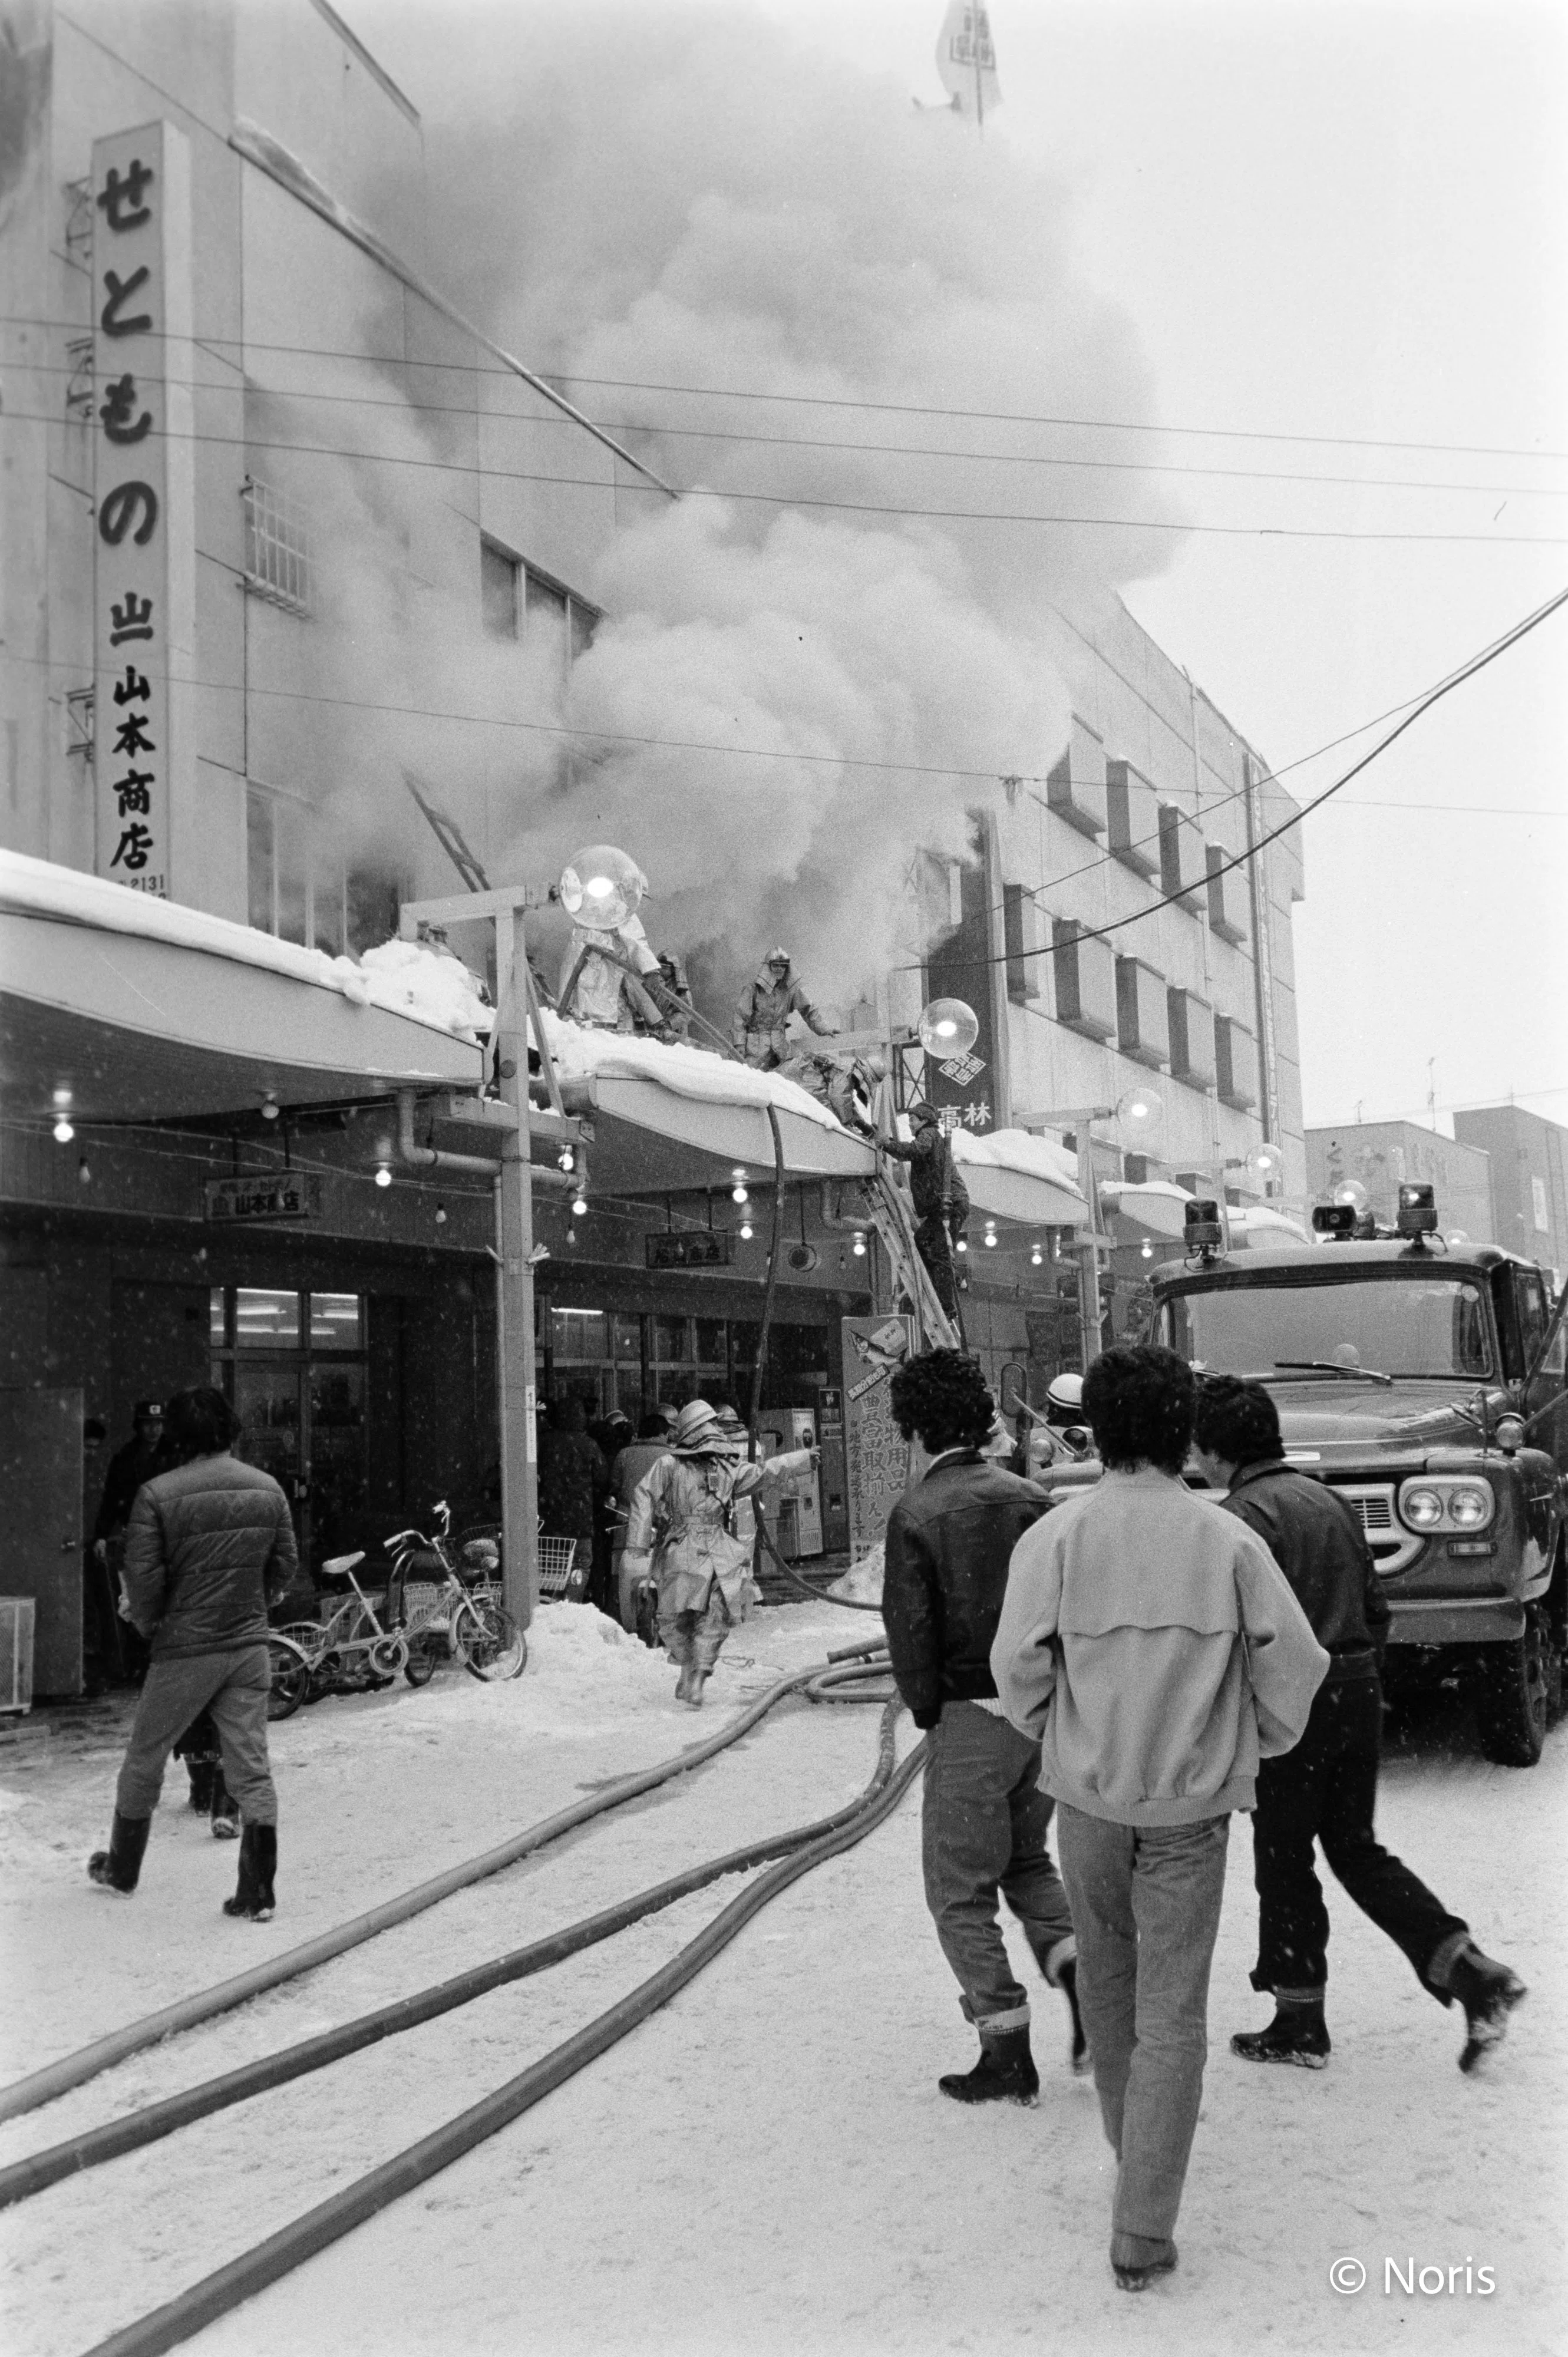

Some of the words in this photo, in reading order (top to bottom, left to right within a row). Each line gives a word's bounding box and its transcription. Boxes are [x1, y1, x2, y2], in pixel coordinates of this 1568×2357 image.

[97, 159, 158, 546] せともの
[110, 665, 156, 870] 山本商店
[937, 1102, 992, 1128] 高林
